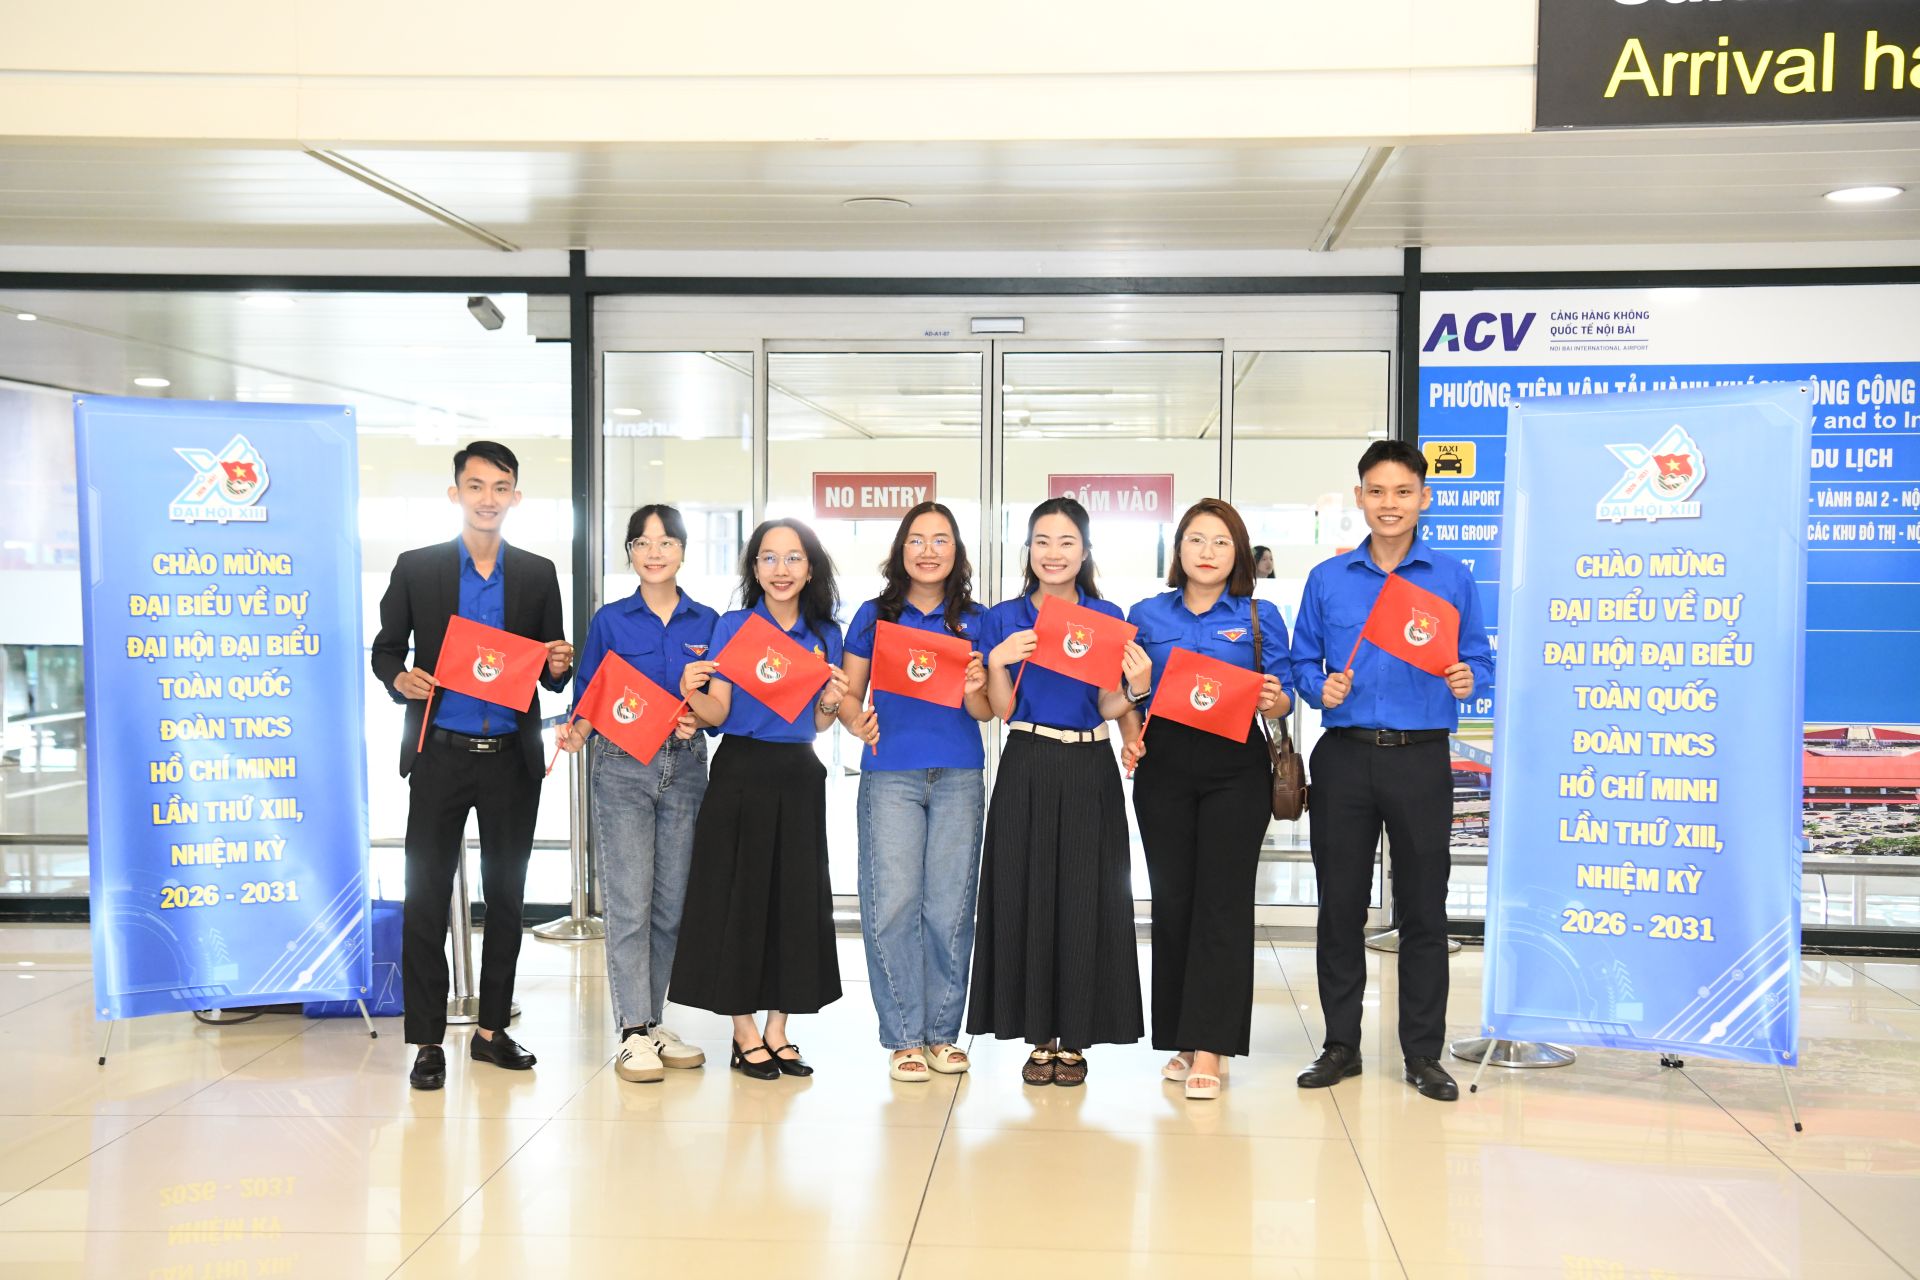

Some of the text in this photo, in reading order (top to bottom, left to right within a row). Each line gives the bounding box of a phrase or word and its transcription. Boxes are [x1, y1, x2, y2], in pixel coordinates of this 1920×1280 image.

[1604, 30, 1920, 98] Arrival h
[1550, 322, 1578, 336] QUỐC
[1581, 322, 1594, 335] TẾ
[1596, 323, 1614, 336] NỘI
[1613, 309, 1650, 320] KHÔNG
[1422, 312, 1537, 352] ACV
[1429, 379, 1511, 408] PHƯƠNG
[1810, 374, 1850, 405] ÔNG
[1856, 373, 1916, 410] CỘNG
[1824, 411, 1866, 429] and
[1874, 412, 1897, 429] to
[1811, 448, 1893, 472] DU LỊCH
[825, 486, 927, 508] NO ENTRY
[1117, 485, 1158, 512] VÀO
[1436, 490, 1459, 507] TAXI
[1461, 490, 1501, 507] AIPORT
[1817, 487, 1852, 507] VÀNH
[1855, 491, 1878, 507] ĐAI
[1881, 491, 1890, 507] 2
[1422, 525, 1499, 541] 2- TAXI GROUP
[1807, 521, 1830, 540] CÁC
[1833, 525, 1856, 540] KHU
[1859, 521, 1875, 540] ĐÔ
[1878, 525, 1896, 544] THỊ
[152, 549, 292, 576] CHÀO MỪNG
[1575, 548, 1726, 578] CHÀO MỪNG
[129, 584, 309, 621] ĐẠI BIỂU VỀ DỰ
[1549, 588, 1745, 626] ĐẠI BIỂU VỀ DỰ
[126, 624, 321, 663] ĐẠI HỘI ĐẠI BIỂU
[1544, 631, 1753, 672] ĐẠI HỘI ĐẠI BIỂU
[158, 667, 291, 701] TOÀN QUỐC
[1574, 678, 1717, 714] TOÀN QUỐC
[159, 714, 292, 742] ĐOÀN TNCS
[1572, 725, 1716, 757] ĐOÀN TNCS
[150, 752, 296, 784] HỒ CHÍ MINH
[1559, 765, 1719, 802] HỒ CHÍ MINH
[152, 794, 304, 826] LẦN THỨ XIII,
[1558, 809, 1724, 854] LẦN THỨ XIII,
[170, 835, 287, 868] NHIỆM KỲ
[1576, 861, 1704, 896] NHIỆM KỲ
[159, 885, 220, 909] 2026
[240, 881, 299, 905] 2031
[1561, 909, 1715, 942] 2026 - 2031
